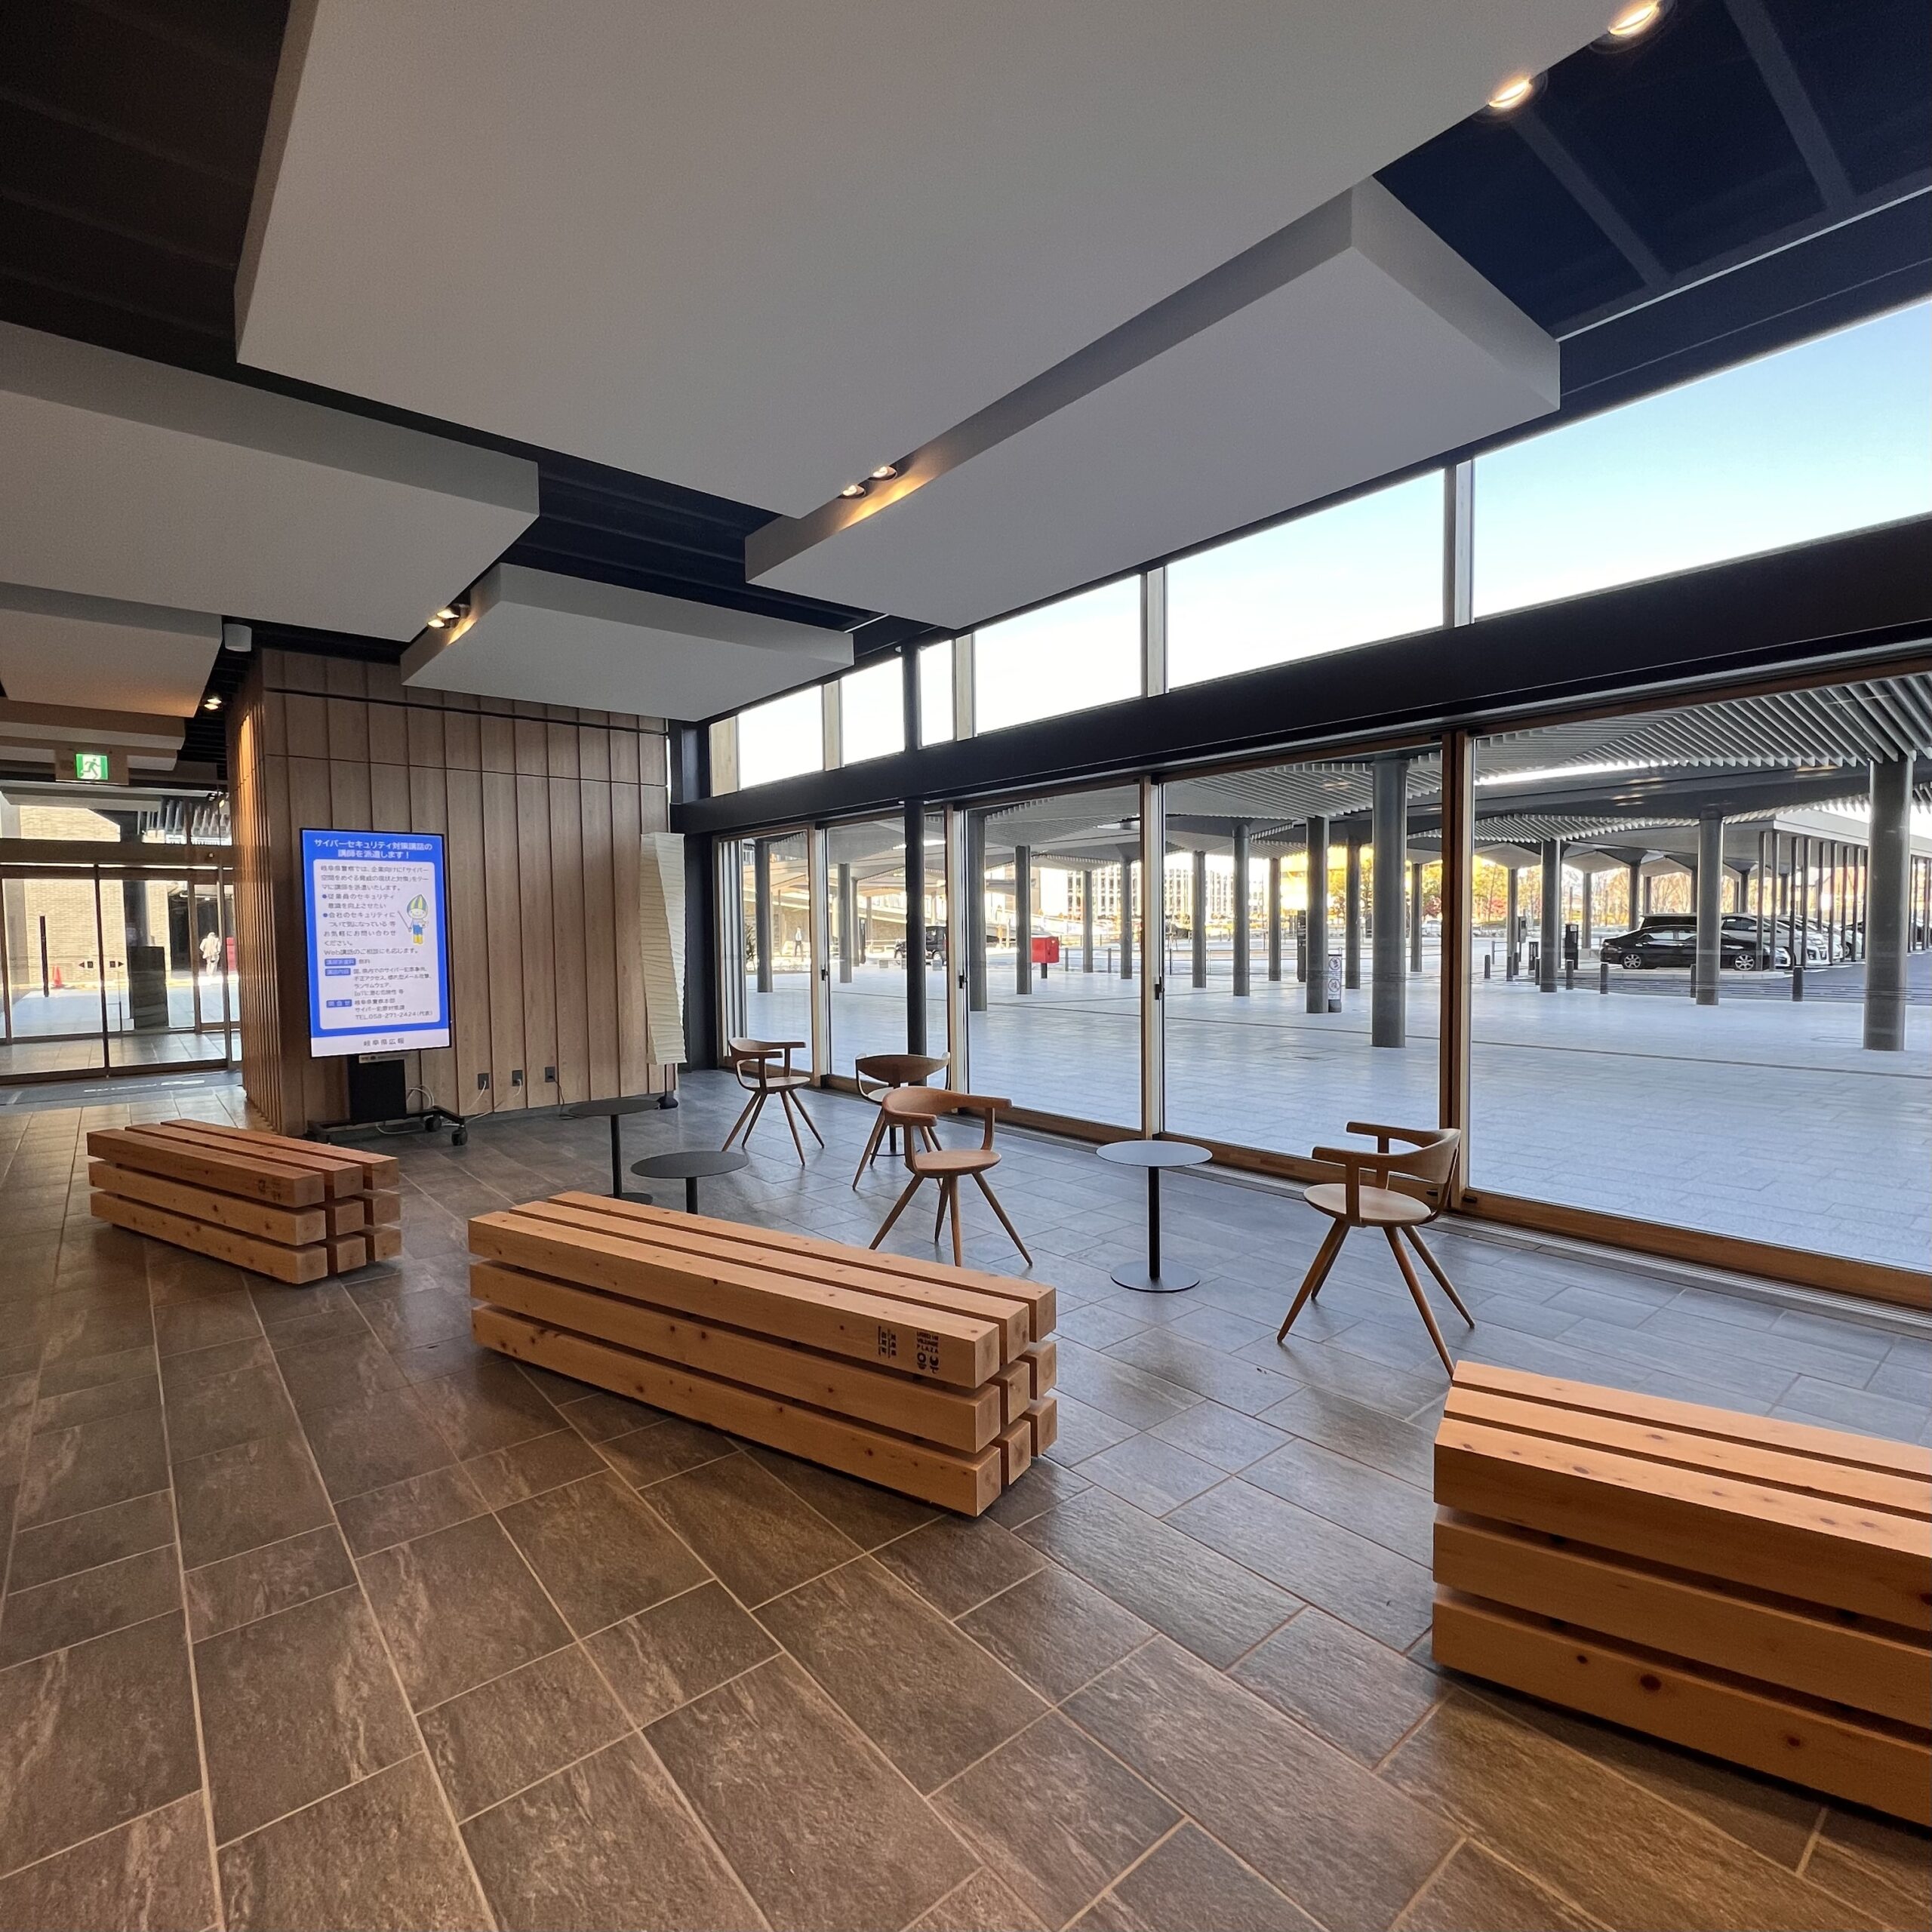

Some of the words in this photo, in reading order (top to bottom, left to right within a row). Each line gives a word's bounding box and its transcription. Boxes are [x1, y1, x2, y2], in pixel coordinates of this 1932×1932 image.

[314, 838, 433, 851] サイバーセキュリティ対策講話の
